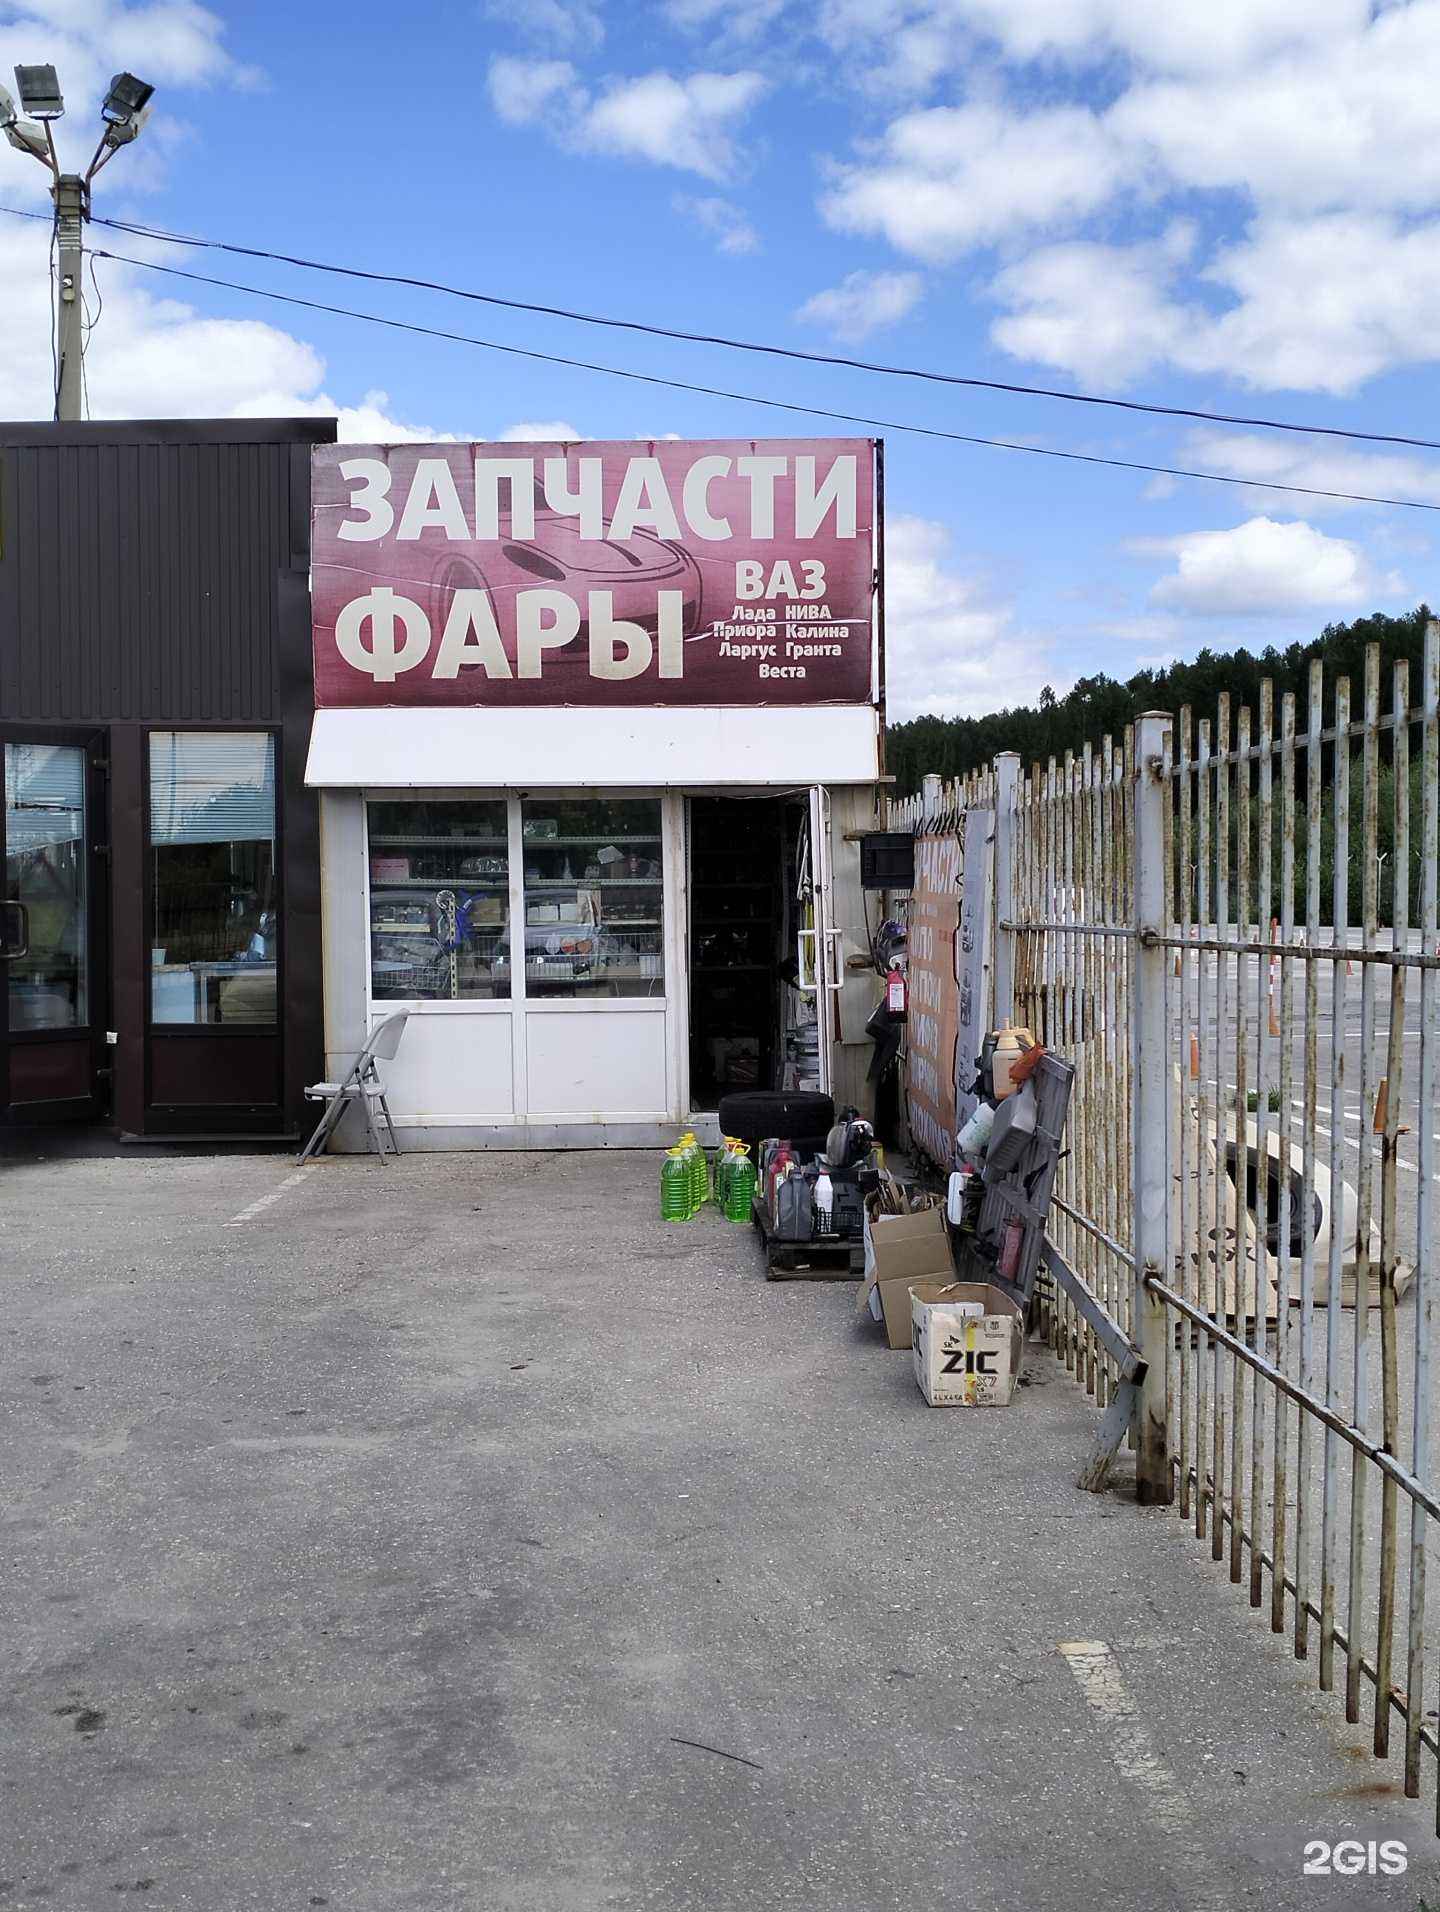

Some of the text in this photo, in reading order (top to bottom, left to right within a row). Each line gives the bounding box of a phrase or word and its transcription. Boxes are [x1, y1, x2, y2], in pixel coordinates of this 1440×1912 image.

[336, 454, 858, 543] ЗАПЧАСТИ
[735, 559, 827, 600] ВАЗ
[732, 604, 832, 622] Лада НИВА
[334, 586, 684, 683] ФАРЫ
[713, 621, 849, 640] Приора Калина
[719, 642, 842, 660] Ларгус Гранта
[759, 663, 806, 678] Веста
[940, 1350, 1000, 1374] ZIC
